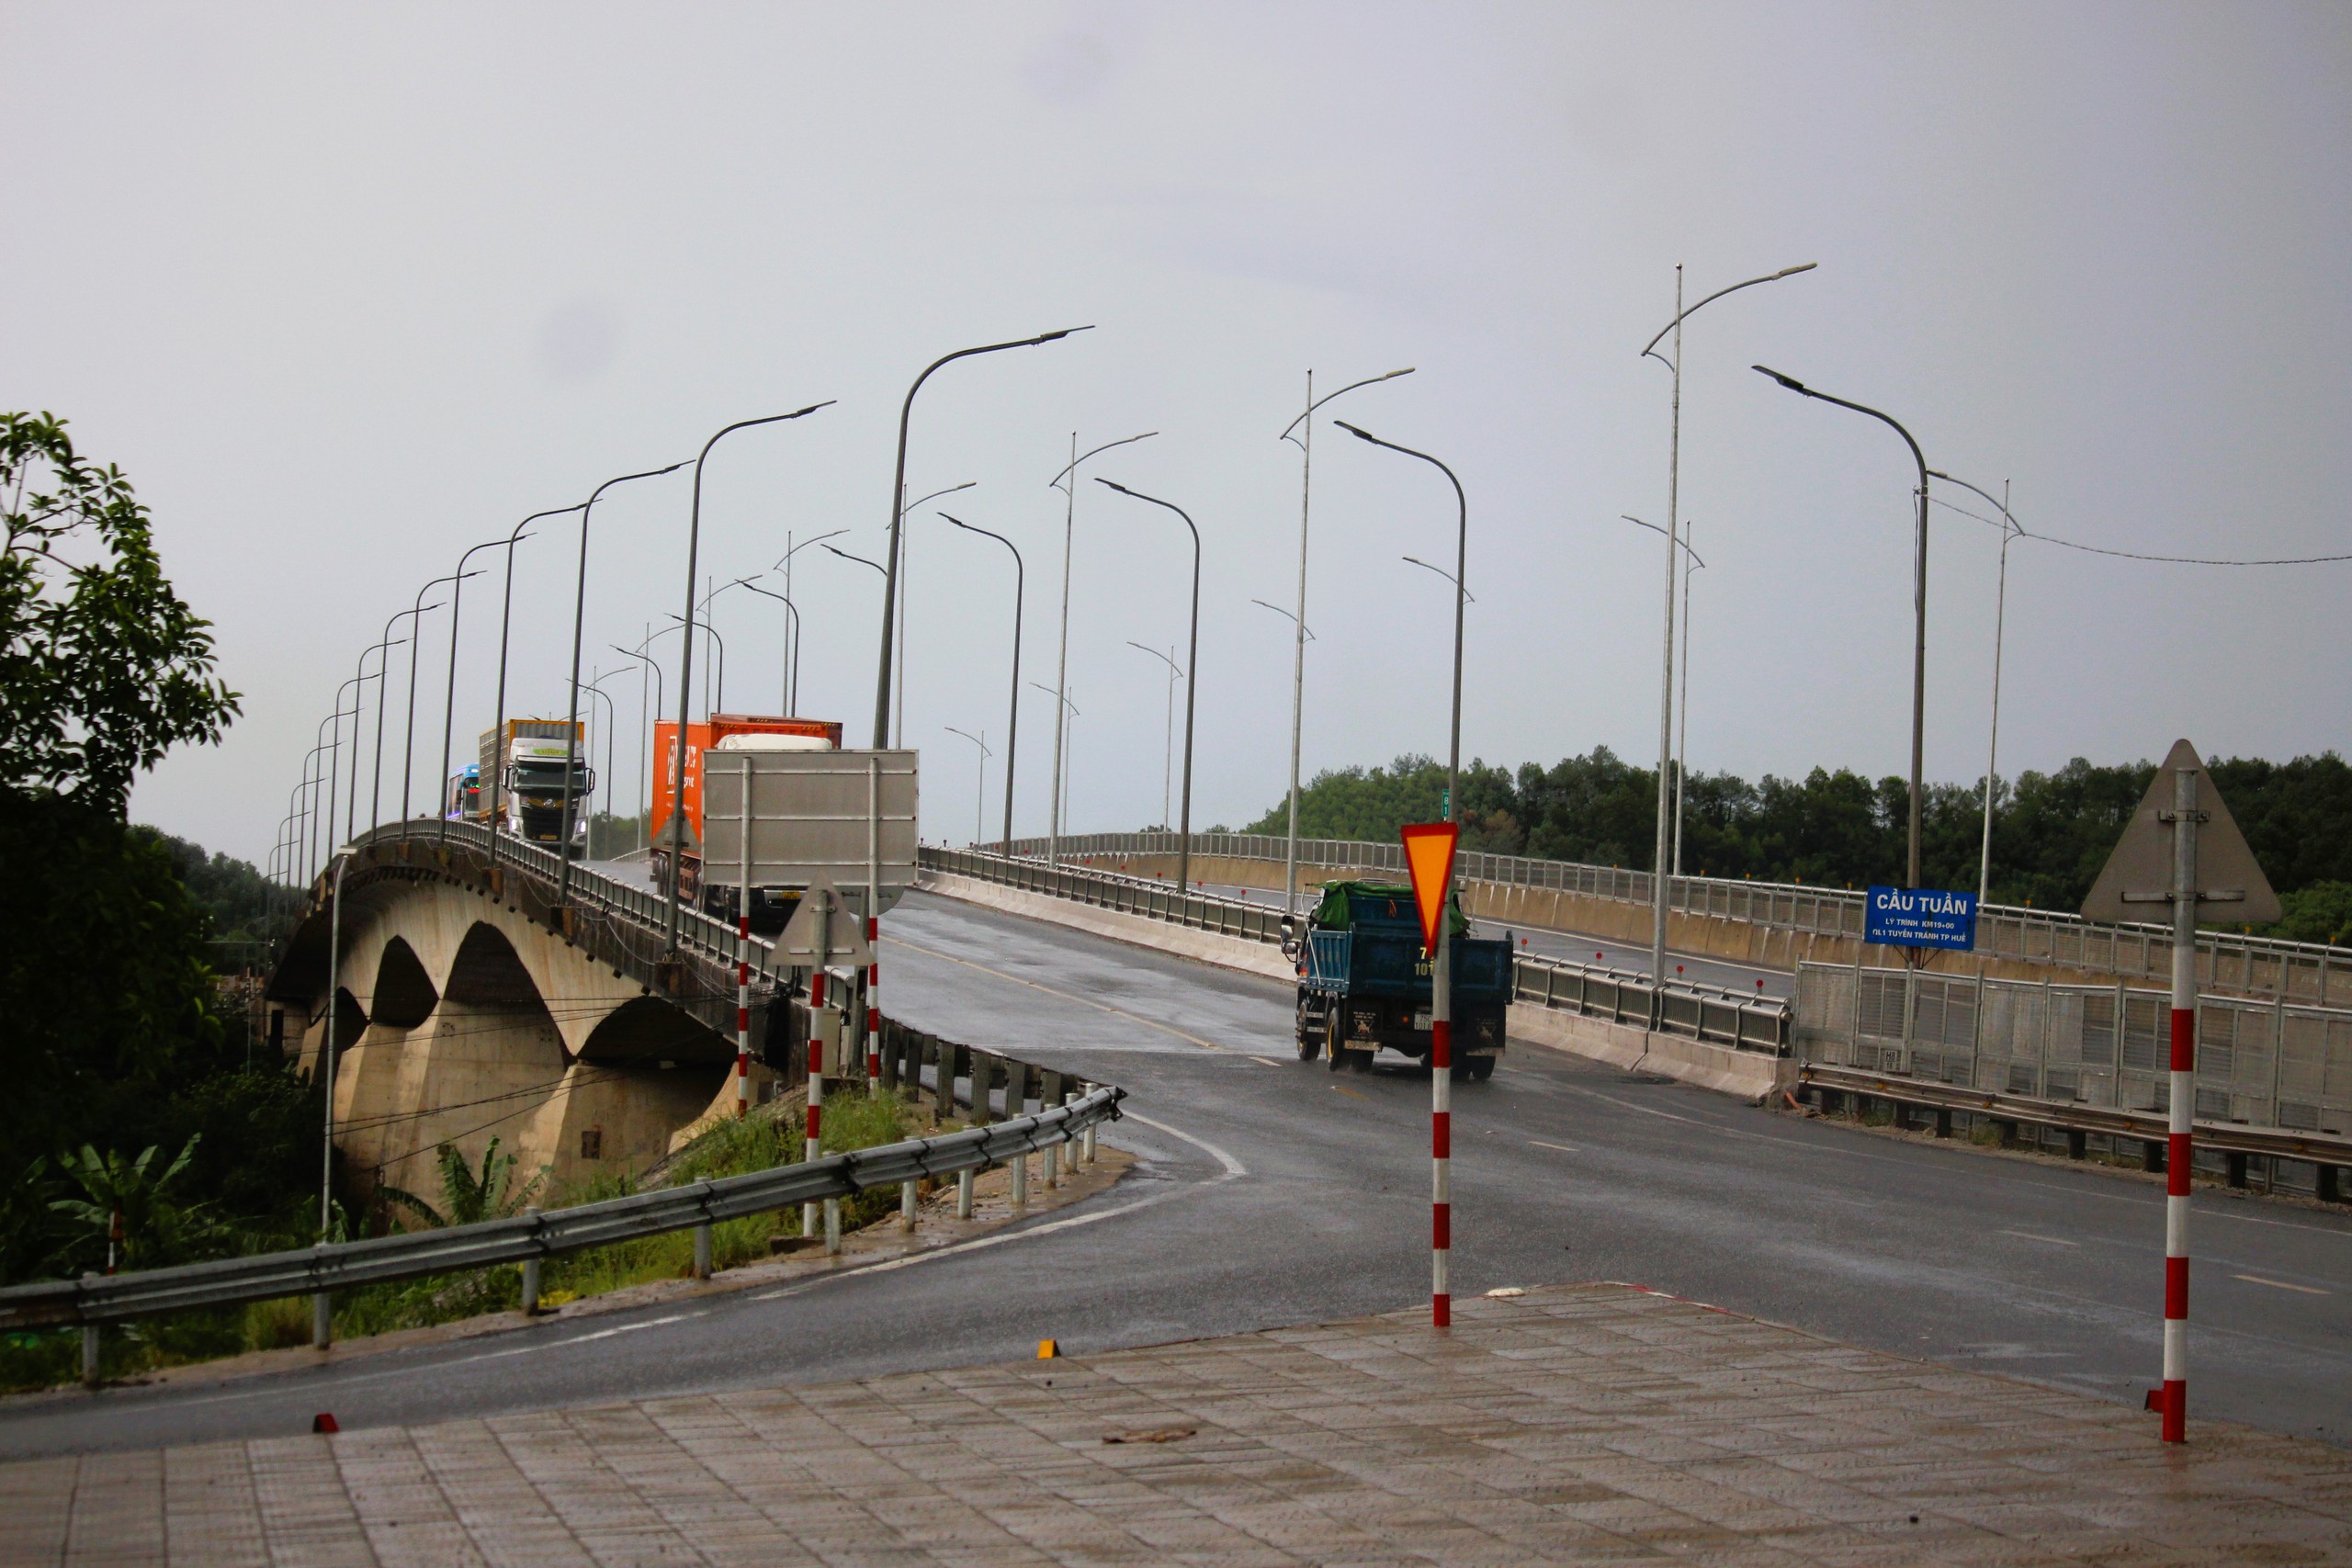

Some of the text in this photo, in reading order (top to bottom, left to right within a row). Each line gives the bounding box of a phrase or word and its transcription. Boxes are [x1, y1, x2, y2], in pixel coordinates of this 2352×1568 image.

[1876, 888, 1967, 915] CẦU TUẦN
[1896, 919, 1918, 927] TRÌNH
[1914, 931, 1939, 941] TRÁNH
